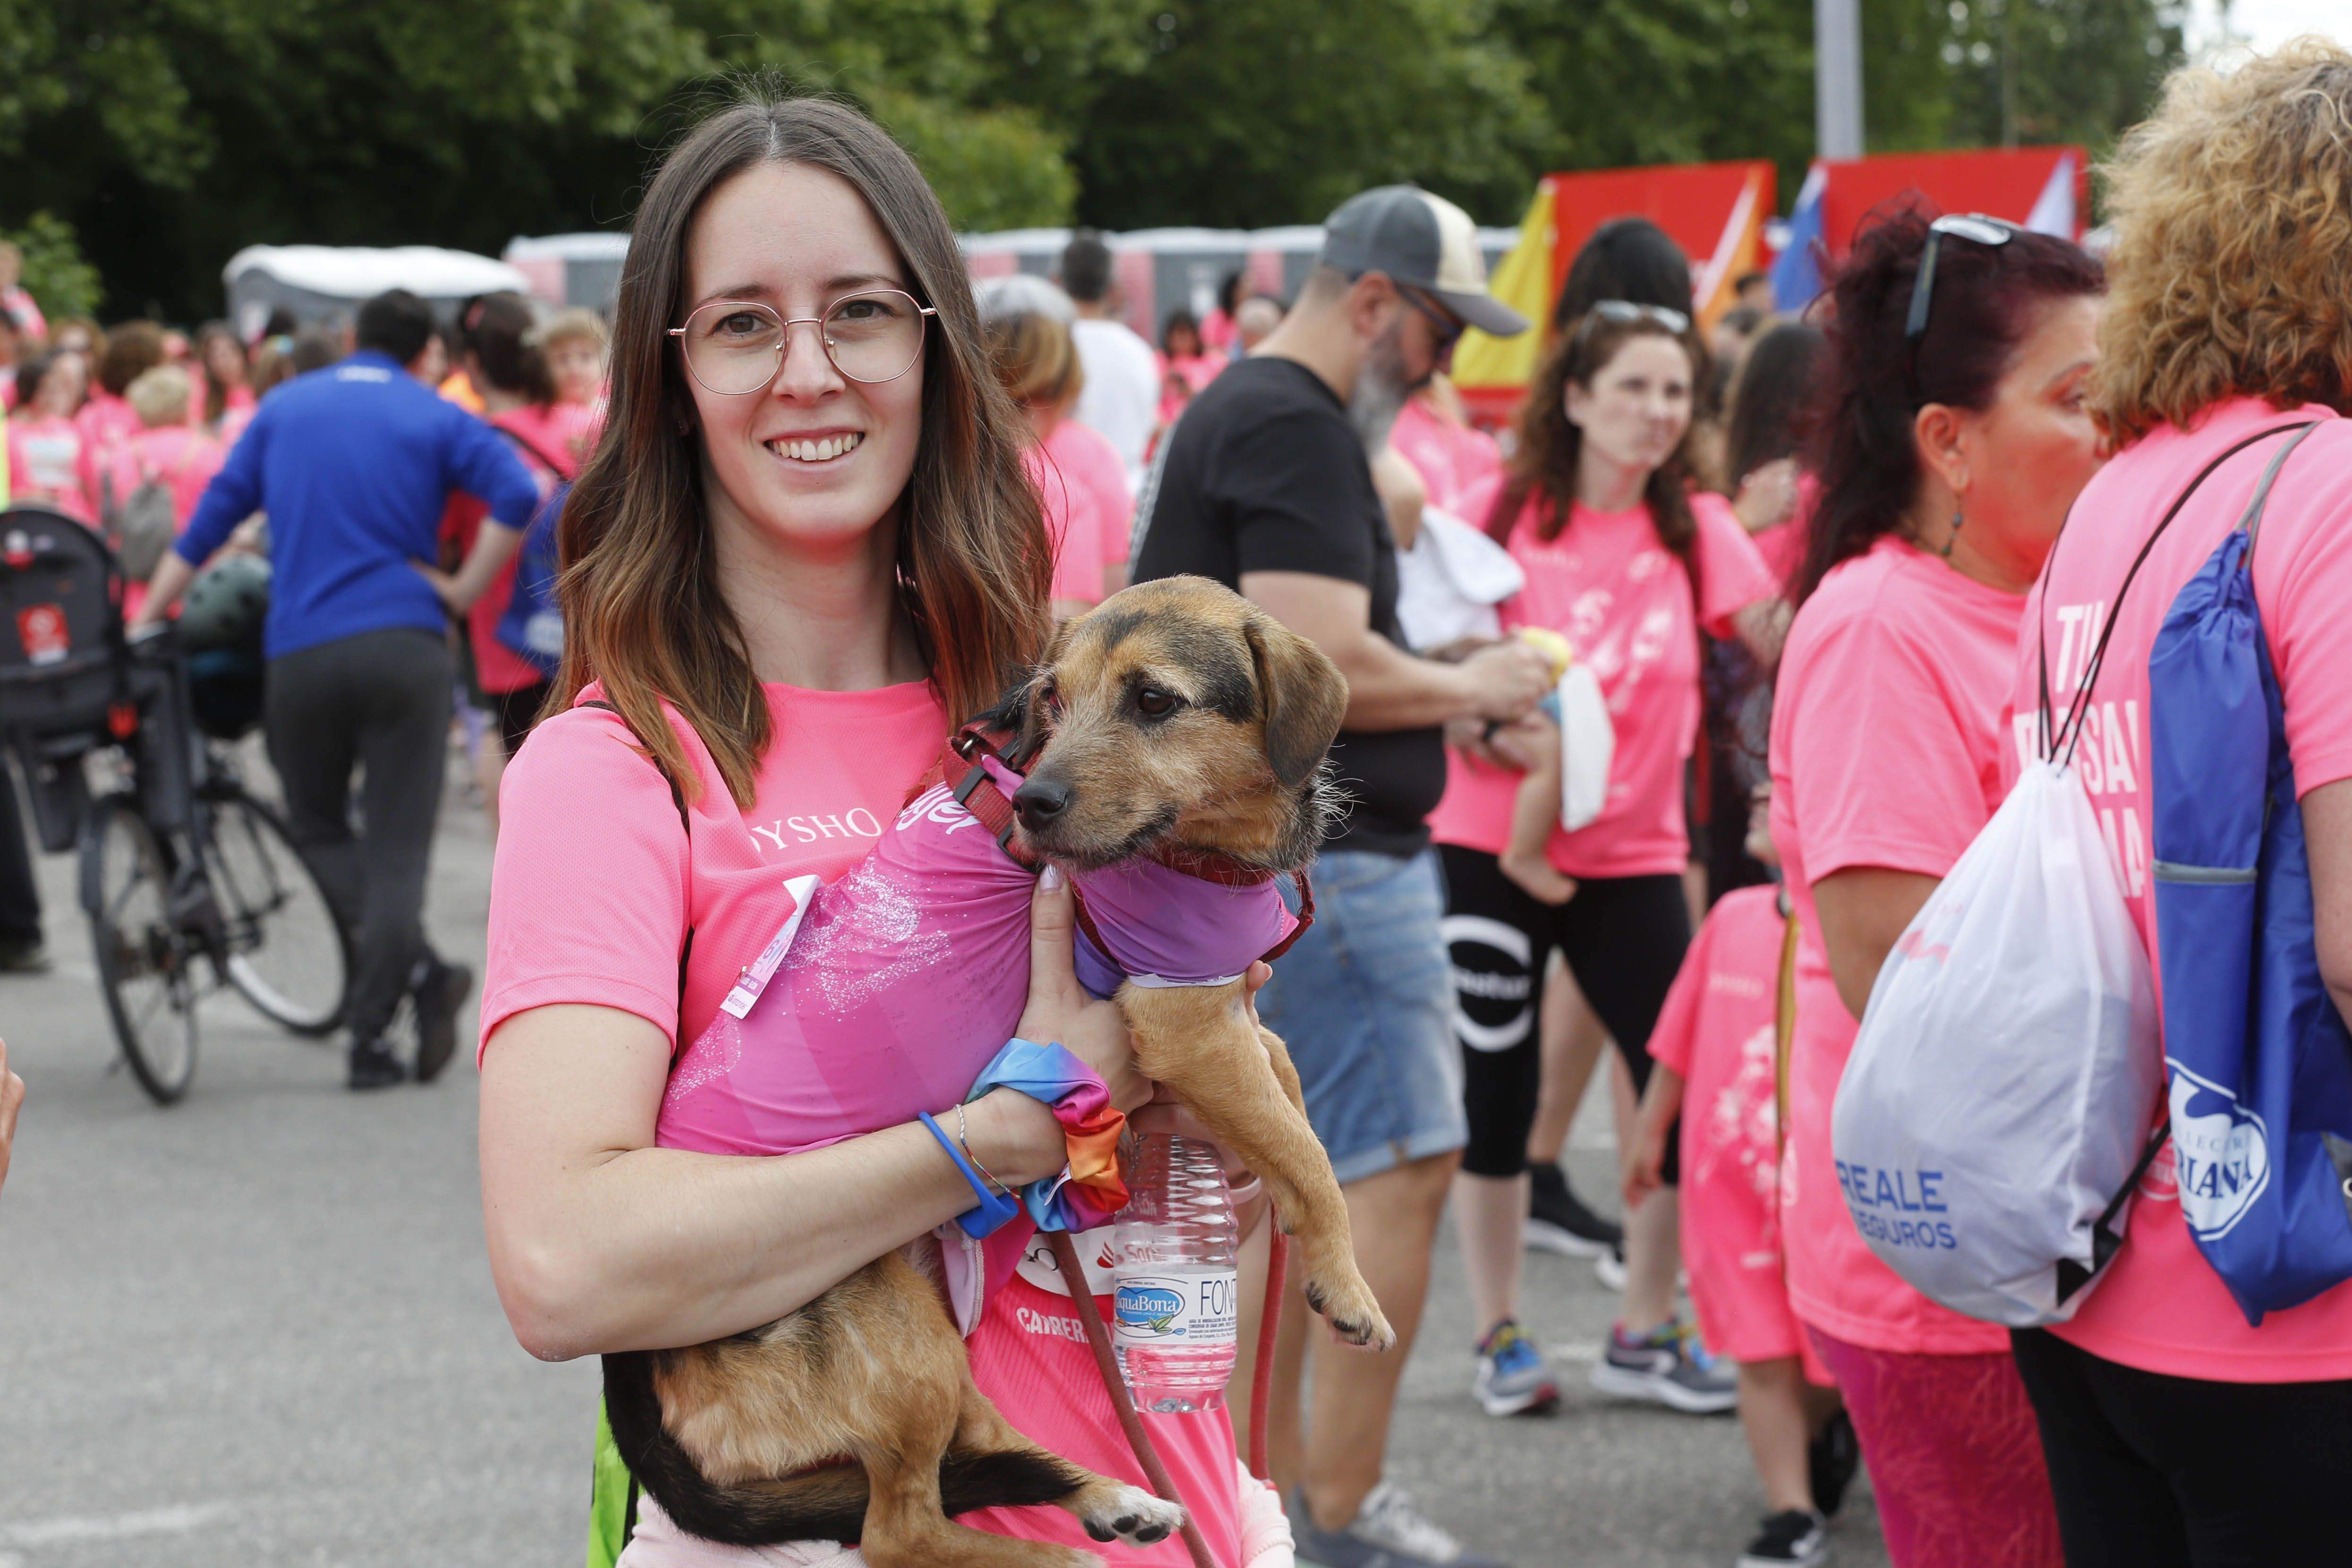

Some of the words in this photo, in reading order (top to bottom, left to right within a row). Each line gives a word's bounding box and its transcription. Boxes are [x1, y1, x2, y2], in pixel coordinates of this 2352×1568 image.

[750, 808, 882, 852] YSHO
[1835, 1160, 1948, 1213] REALE
[1851, 1208, 1957, 1250] EGUROS
[1016, 1307, 1089, 1344] CARRER
